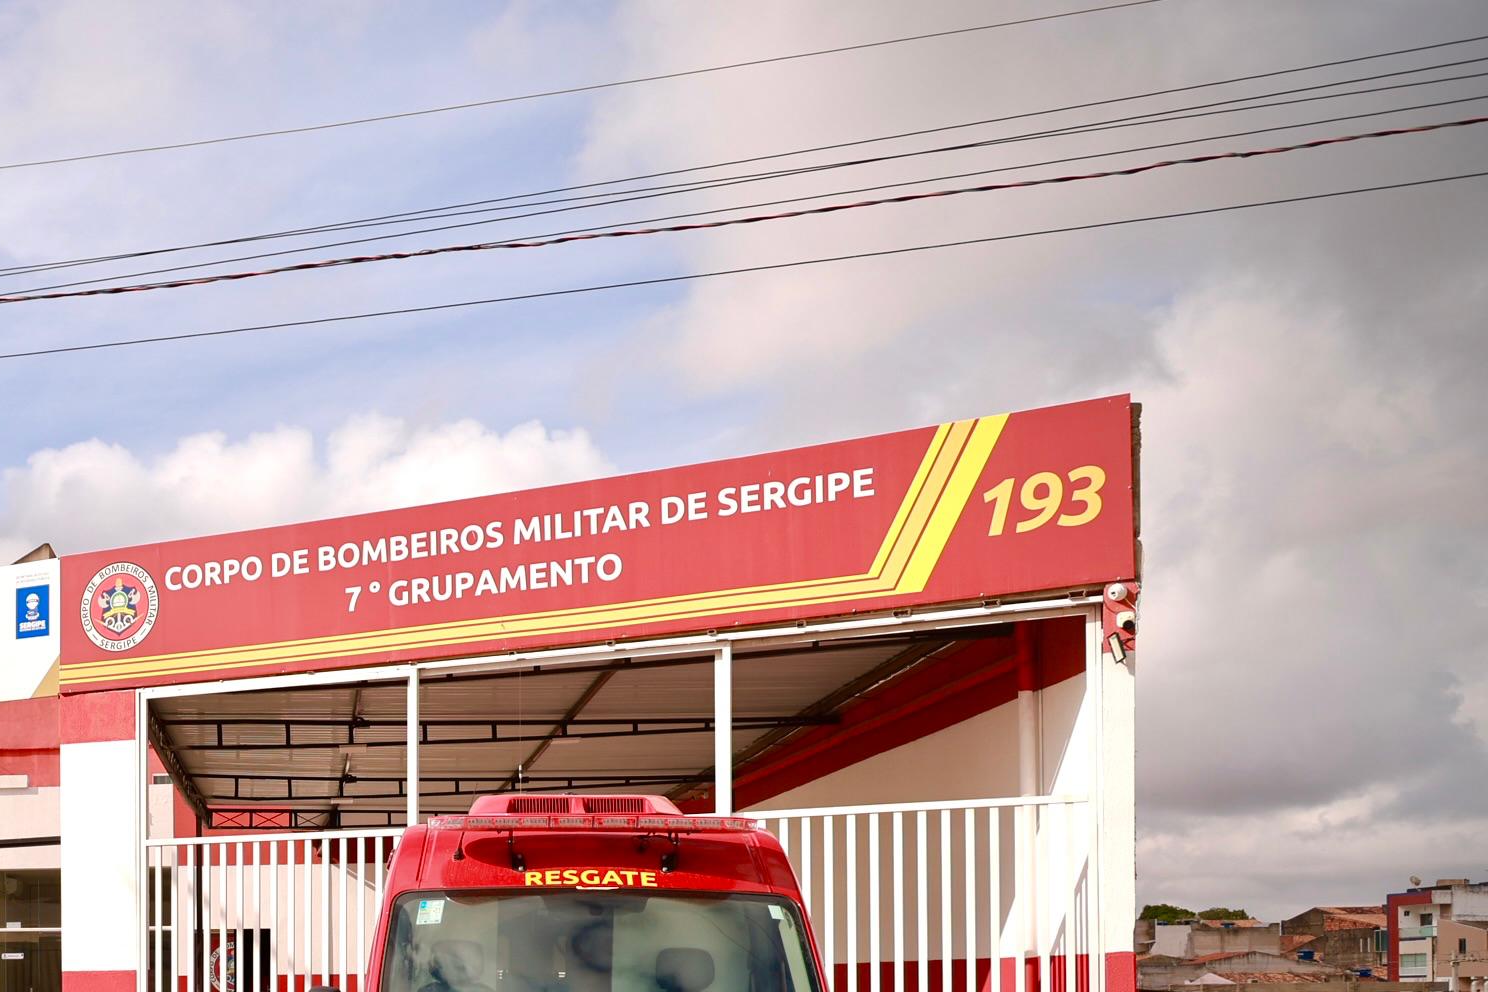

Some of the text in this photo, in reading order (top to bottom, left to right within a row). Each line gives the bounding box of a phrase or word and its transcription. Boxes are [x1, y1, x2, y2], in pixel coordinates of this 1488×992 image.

[164, 467, 875, 591] CORPO DE BOMBEIROS MILITAR DE SERGIPE
[983, 465, 1107, 537] 193
[82, 564, 157, 632] CORPO DE BOMBEIROS MILITAR
[388, 553, 623, 606] GRUPAMENTO
[100, 637, 137, 650] SERGIPE
[524, 869, 658, 887] RESGATE
